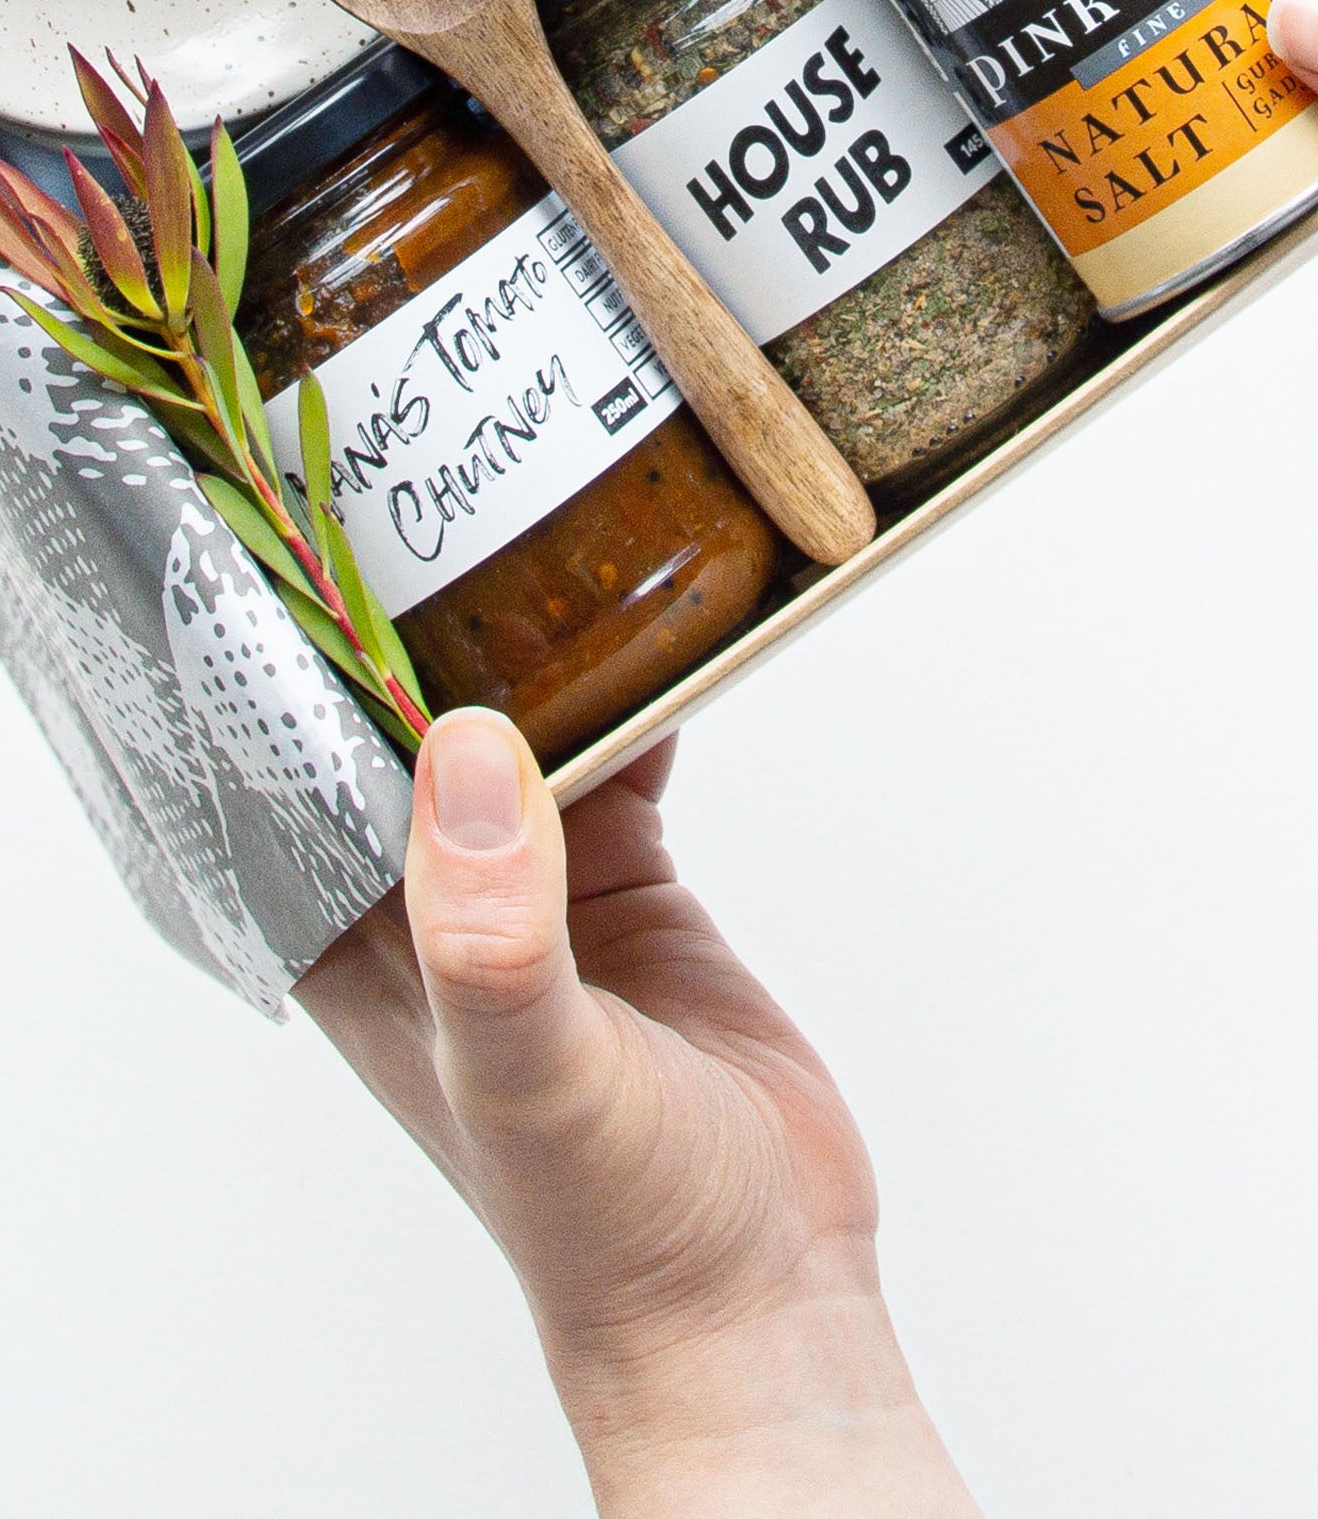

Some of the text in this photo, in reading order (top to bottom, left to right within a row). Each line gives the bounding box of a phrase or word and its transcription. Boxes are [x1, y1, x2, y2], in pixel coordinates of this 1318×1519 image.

[1117, 1, 1187, 59] FINE
[685, 24, 882, 242] HOUSE
[1073, 112, 1214, 224] SALT
[781, 128, 913, 276] RUB
[600, 386, 639, 427] 250ml
